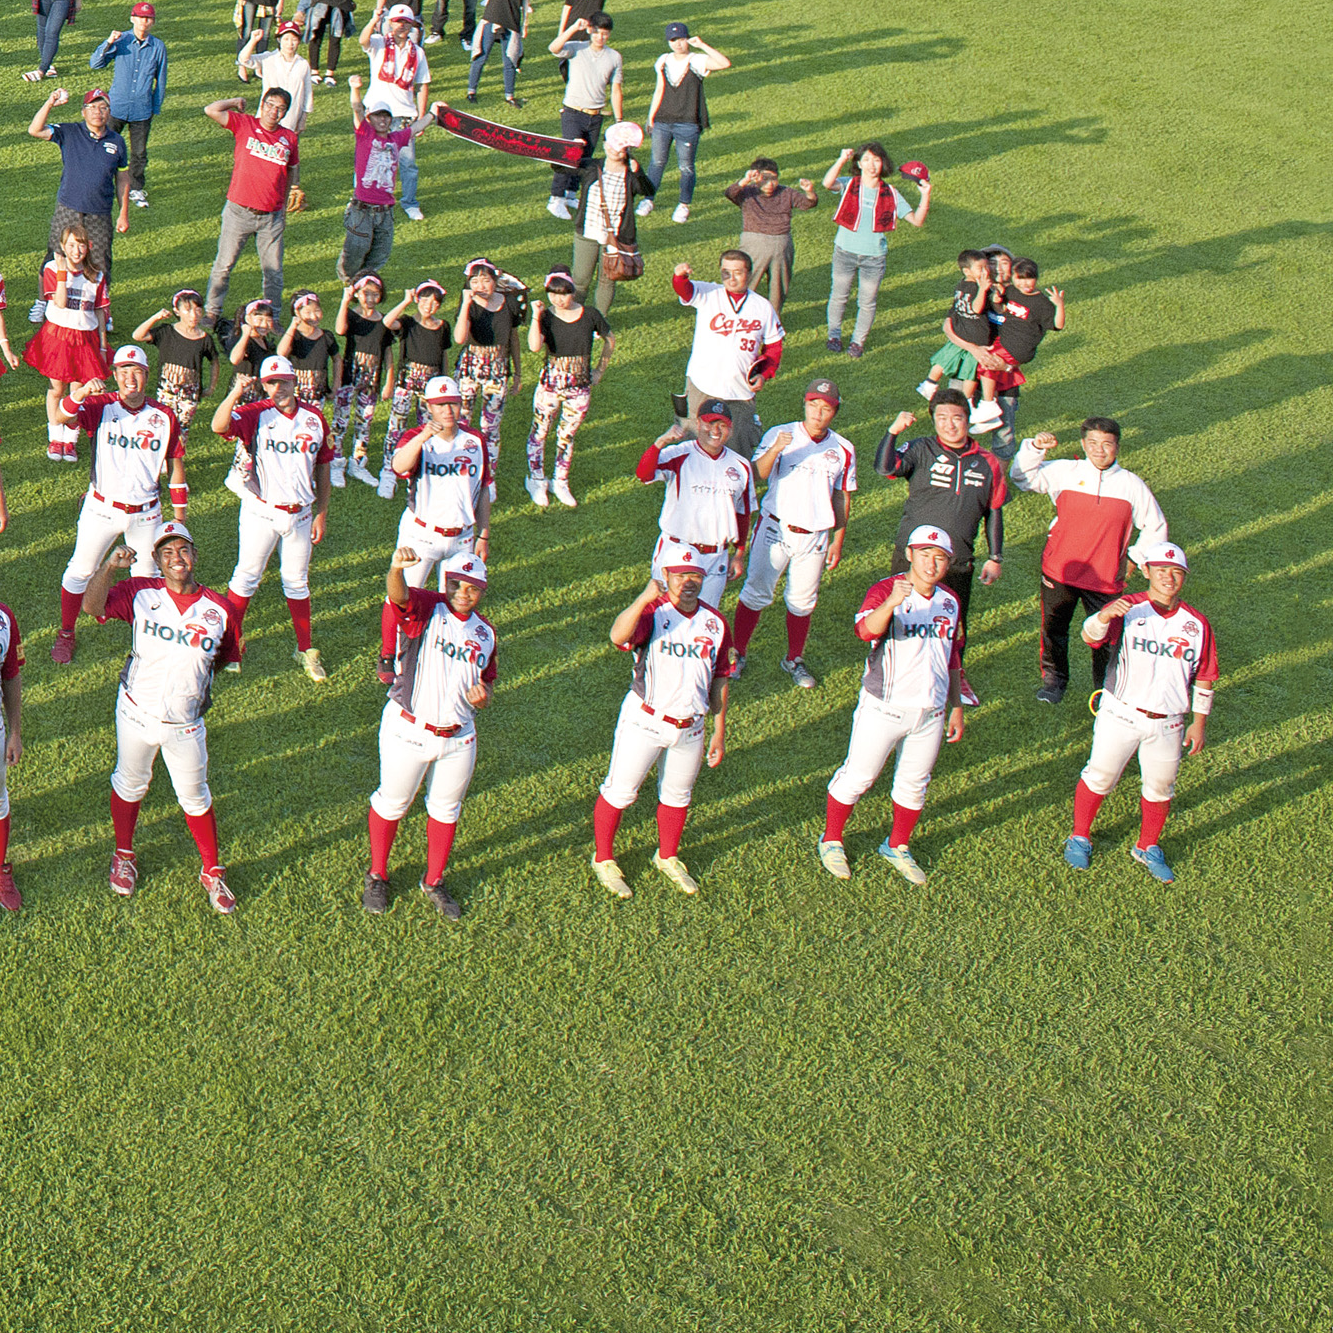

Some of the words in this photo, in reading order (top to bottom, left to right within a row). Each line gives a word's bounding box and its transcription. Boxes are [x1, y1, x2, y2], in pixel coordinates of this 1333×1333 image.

[740, 337, 757, 353] 33
[108, 430, 161, 452] HOKTO
[265, 434, 318, 454] HOKTO
[426, 456, 477, 478] HOKTO
[143, 619, 214, 654] HOKTO
[903, 616, 954, 642] HOKTO
[435, 640, 486, 671] HOKTO
[660, 636, 716, 660] HOKTO
[1132, 637, 1195, 663] HOKTO
